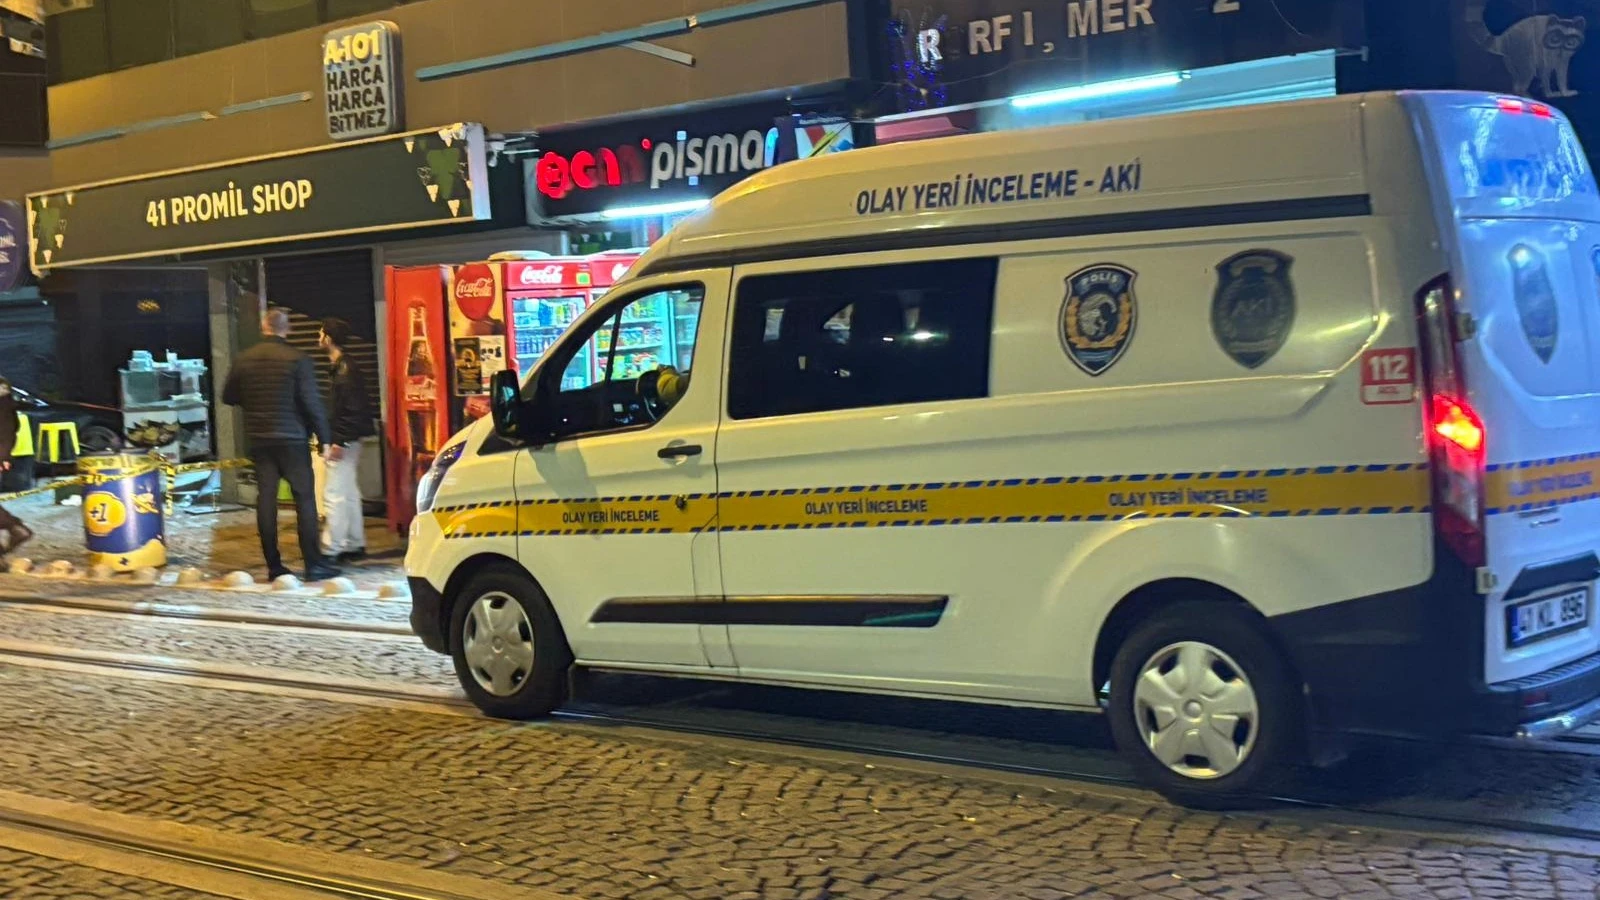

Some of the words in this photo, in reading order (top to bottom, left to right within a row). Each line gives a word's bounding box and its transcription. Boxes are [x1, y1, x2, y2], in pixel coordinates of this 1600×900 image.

[327, 65, 384, 92] HARCA
[328, 87, 385, 113] HARCA
[330, 109, 387, 134] BİTMEZ
[856, 187, 908, 215] OLAY
[912, 175, 960, 210] YERİ
[964, 173, 1078, 204] İNCELEME
[1099, 157, 1141, 193] AKİ
[146, 200, 167, 227] 41
[171, 181, 248, 225] PROMİL
[252, 179, 312, 214] SHOP
[1370, 354, 1409, 381] 112
[563, 511, 586, 523] OLAY
[611, 508, 660, 523] İNCELEME
[805, 502, 832, 515] OLAY
[866, 498, 928, 514] İNCELEME
[1562, 593, 1583, 622] 896
